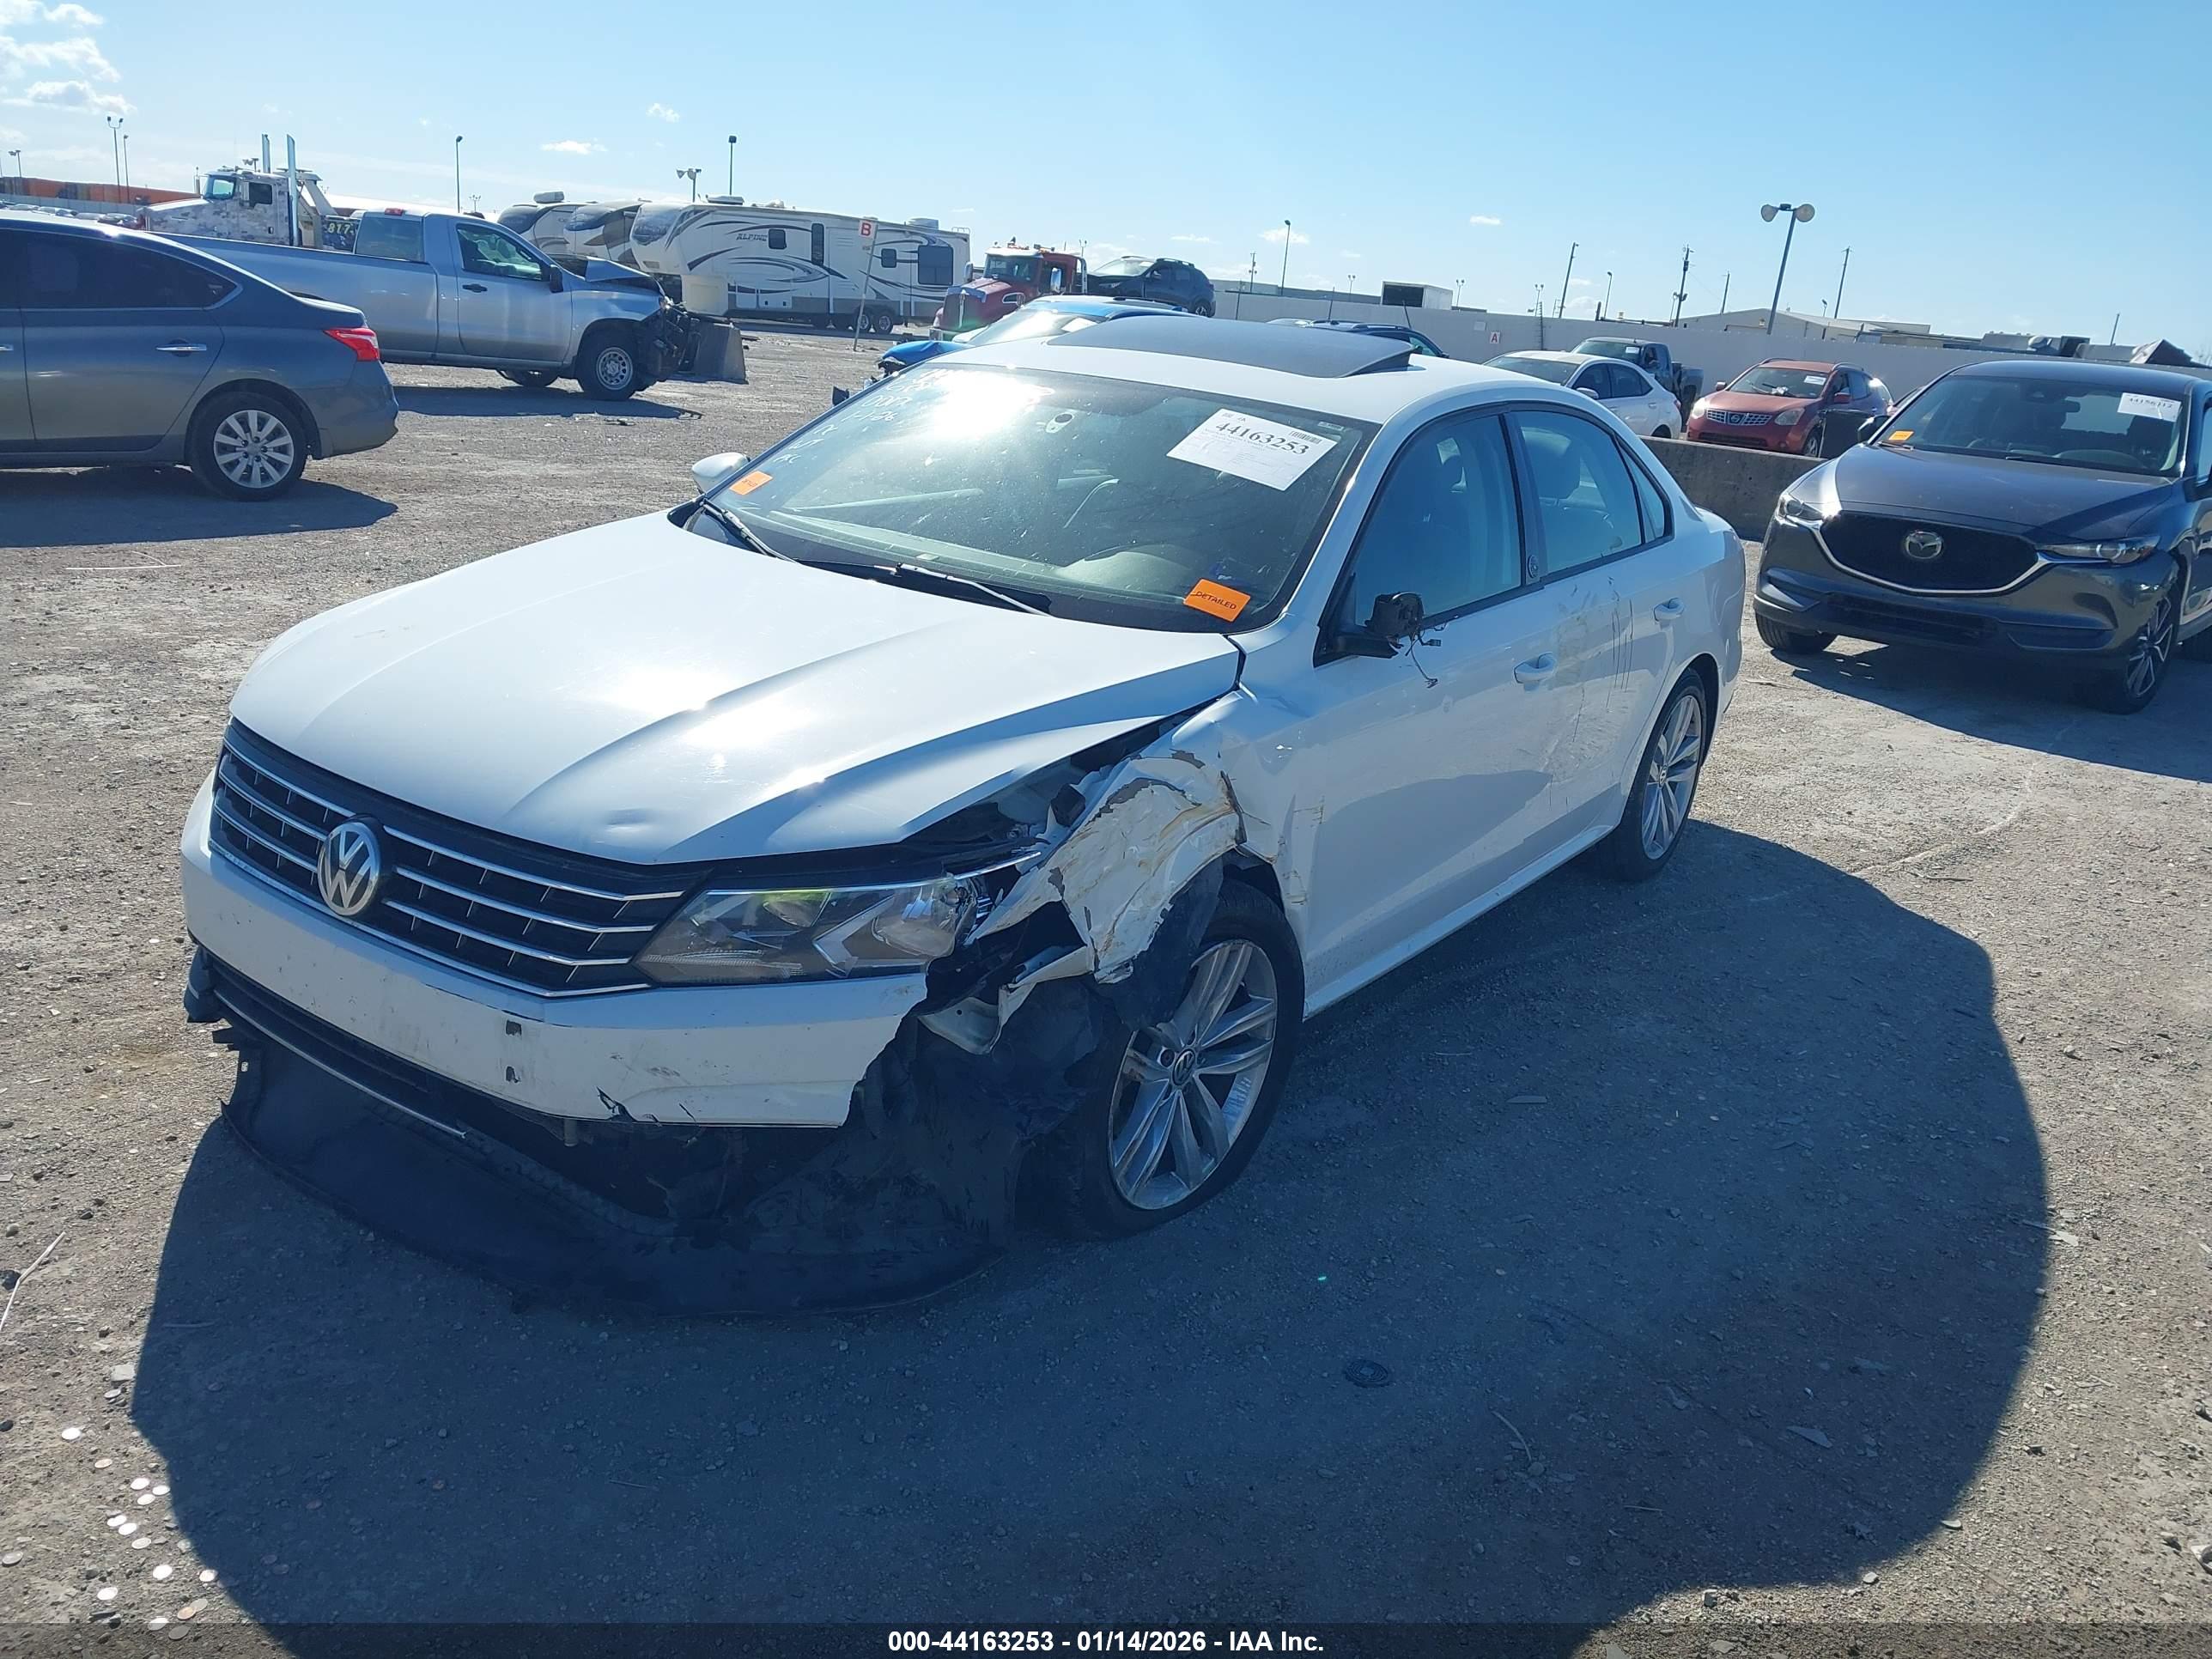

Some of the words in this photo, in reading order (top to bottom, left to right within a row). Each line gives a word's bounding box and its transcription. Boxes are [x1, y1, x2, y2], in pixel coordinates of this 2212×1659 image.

[860, 222, 872, 236] B
[736, 233, 768, 241] ALPINE
[1491, 332, 1498, 343] A
[1216, 422, 1309, 454] 44163253
[1195, 591, 1237, 610] DETAILED
